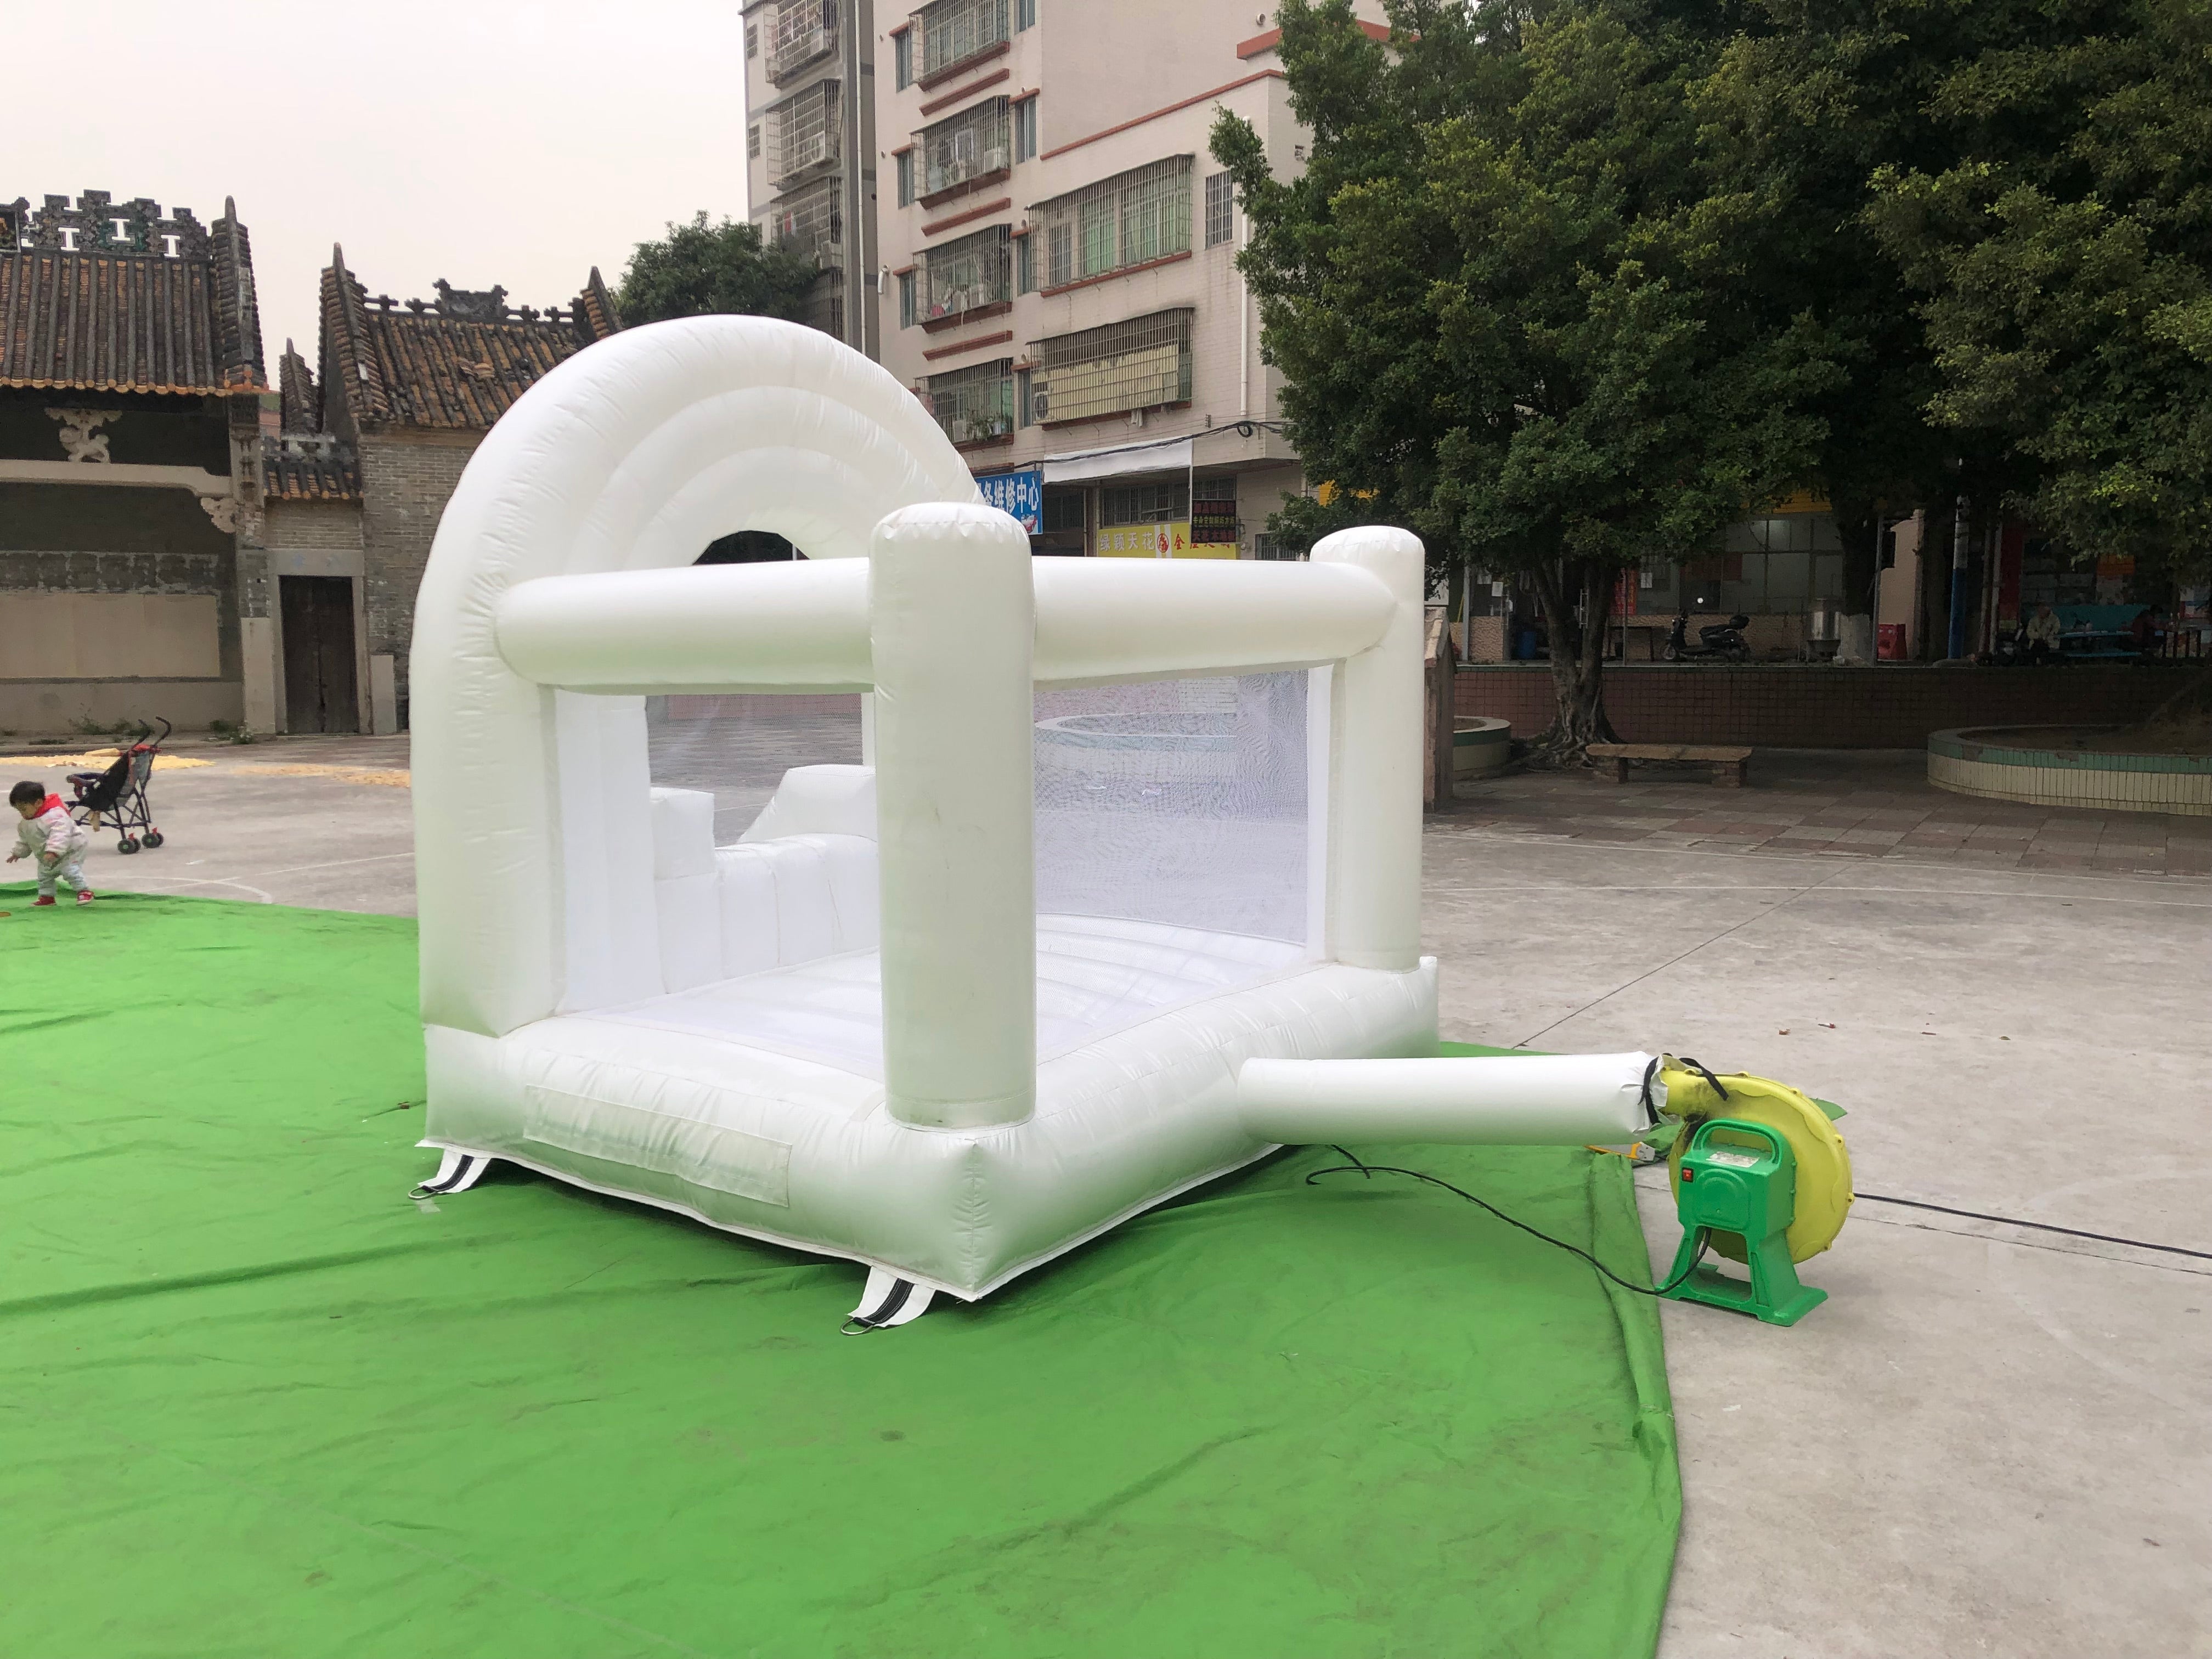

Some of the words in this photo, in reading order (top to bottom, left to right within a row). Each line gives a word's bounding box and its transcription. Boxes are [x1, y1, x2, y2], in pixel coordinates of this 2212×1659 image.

[977, 476, 1039, 514] 备维修中心
